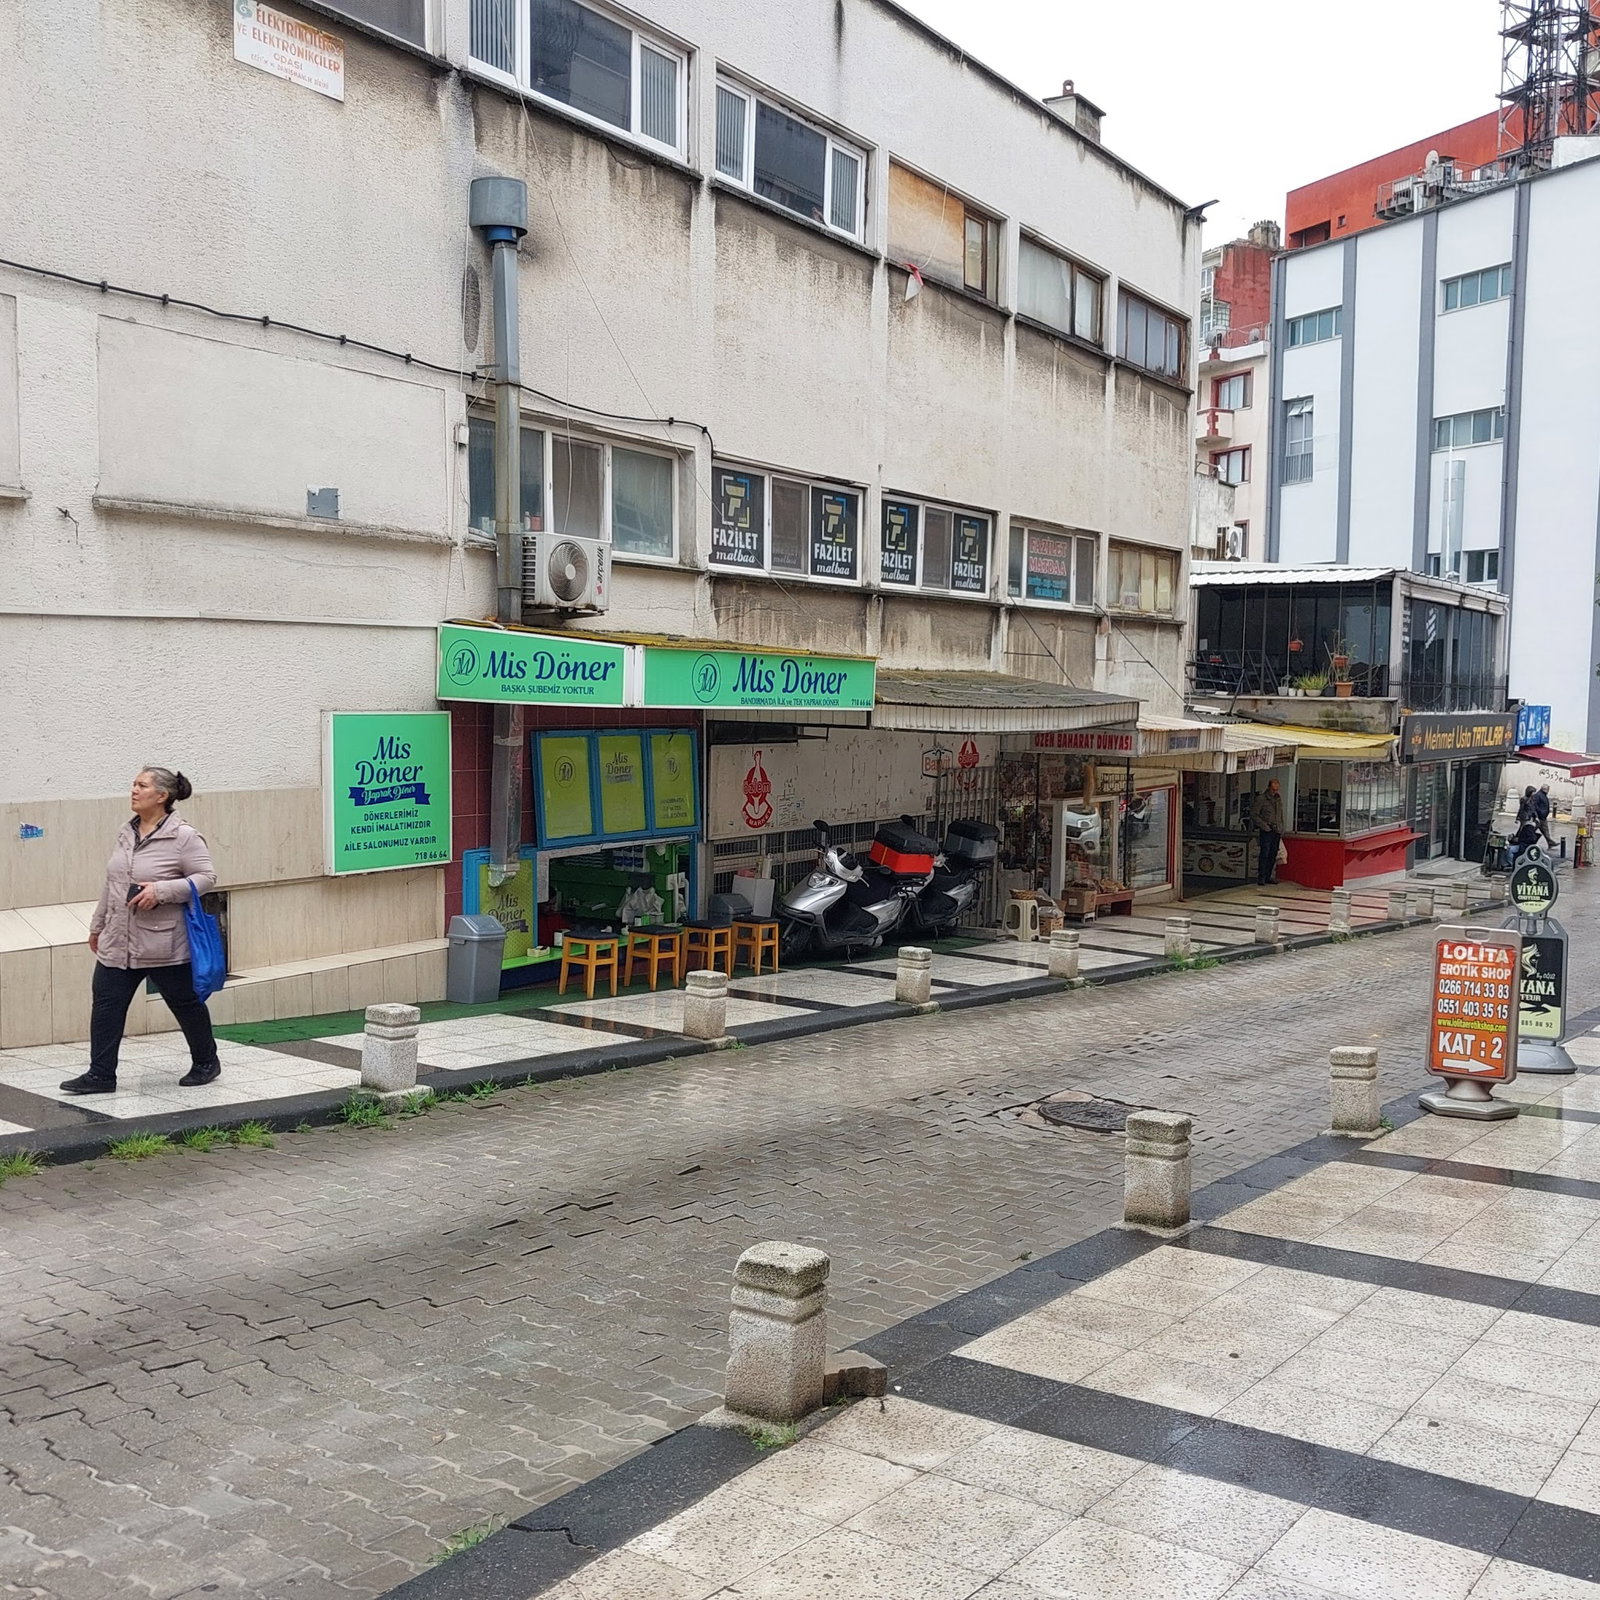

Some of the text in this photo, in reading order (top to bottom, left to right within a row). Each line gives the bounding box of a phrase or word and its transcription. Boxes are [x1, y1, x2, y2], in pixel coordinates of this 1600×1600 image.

[713, 527, 758, 550] FAZİLET
[814, 542, 853, 563] FAZİLET
[954, 561, 984, 579] FAZİLET
[482, 650, 616, 682] Mis Döner
[732, 656, 847, 695] Mis Döner
[501, 684, 594, 696] BAŞKA ŞUBEMİZ YOKTUR
[1057, 733, 1095, 749] BAHARAT
[1097, 732, 1133, 751] DÜNYASI
[1423, 724, 1455, 750] Mehmet
[373, 736, 411, 760] Mis
[355, 761, 423, 785] Döner
[925, 757, 951, 771] Bavit
[364, 808, 419, 822] DÖNERLERİMİZ
[351, 821, 431, 835] KENDİ İMALATIMIZDIR
[344, 836, 437, 852] AİLE SALONUMUZ VARDIR
[415, 852, 428, 860] 718
[1517, 882, 1549, 897] VİYANA
[1443, 944, 1509, 964] LOLİTA
[1440, 962, 1511, 980] EROTİK SHOP
[1439, 979, 1509, 999] 0266 714 33 83
[1520, 979, 1556, 996] YANA
[1438, 999, 1508, 1019] 0551 403 35 15
[1439, 1031, 1476, 1056] KAT
[1491, 1037, 1502, 1059] 2
